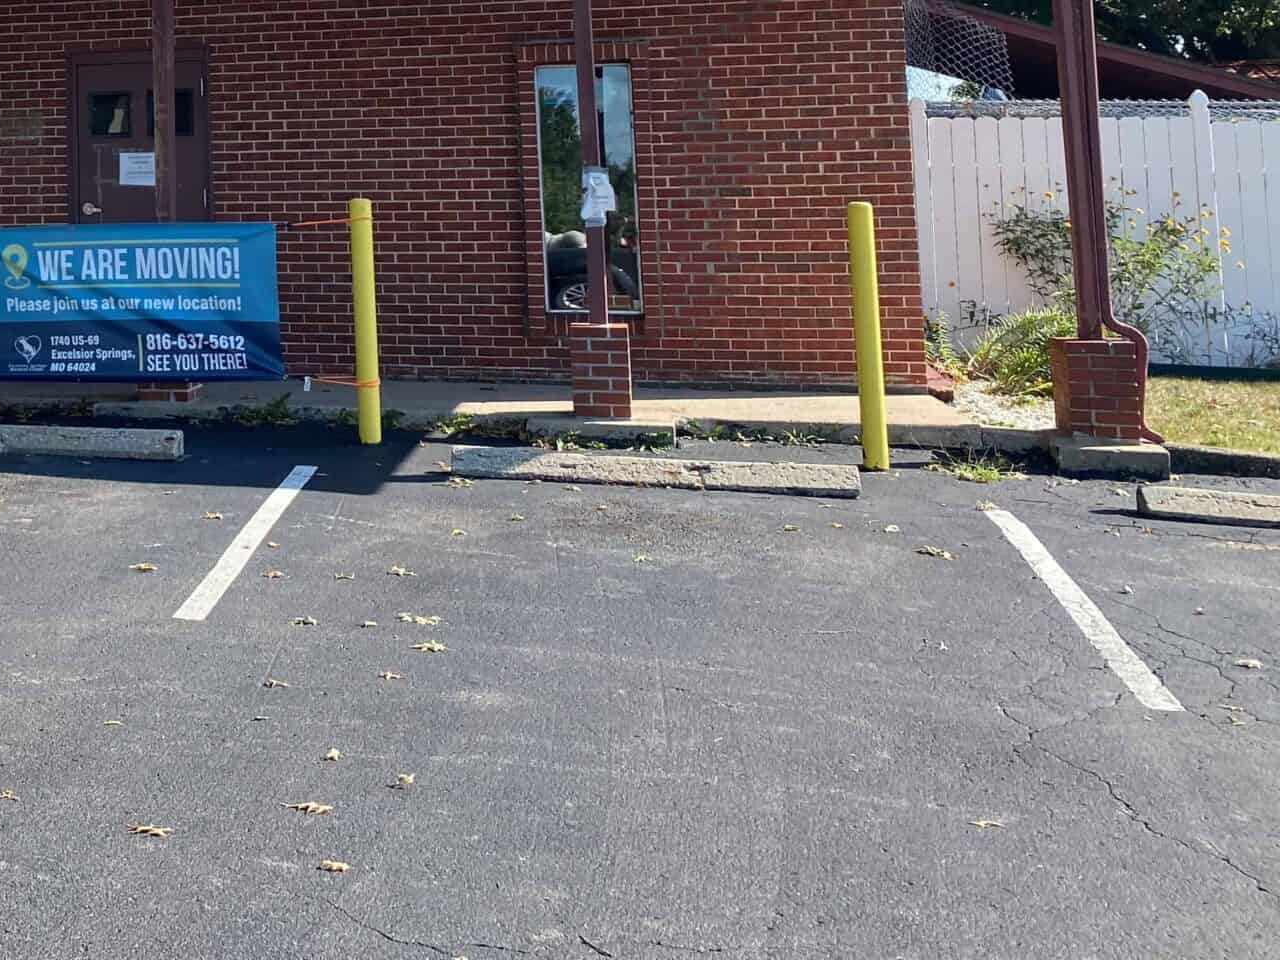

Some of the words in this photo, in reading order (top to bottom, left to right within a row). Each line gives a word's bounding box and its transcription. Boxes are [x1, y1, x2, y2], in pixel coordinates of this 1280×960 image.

[37, 249, 74, 281] WE
[81, 247, 129, 280] ARE
[135, 246, 240, 280] MOVING!
[6, 296, 51, 312] Please
[53, 295, 79, 314] join
[81, 299, 98, 311] us
[101, 296, 116, 311] at
[118, 298, 141, 310] our
[143, 298, 175, 310] new
[177, 295, 241, 311] location!
[50, 335, 71, 346] 1740
[71, 335, 100, 346] US-69
[146, 333, 246, 351] 816-637-5612
[51, 348, 94, 360] Excelsior
[95, 347, 136, 361] Springs,
[146, 354, 171, 372] SEE
[173, 353, 200, 371] YOU
[201, 352, 248, 371] THERE!
[50, 362, 66, 372] MO
[66, 362, 97, 372] 64024
